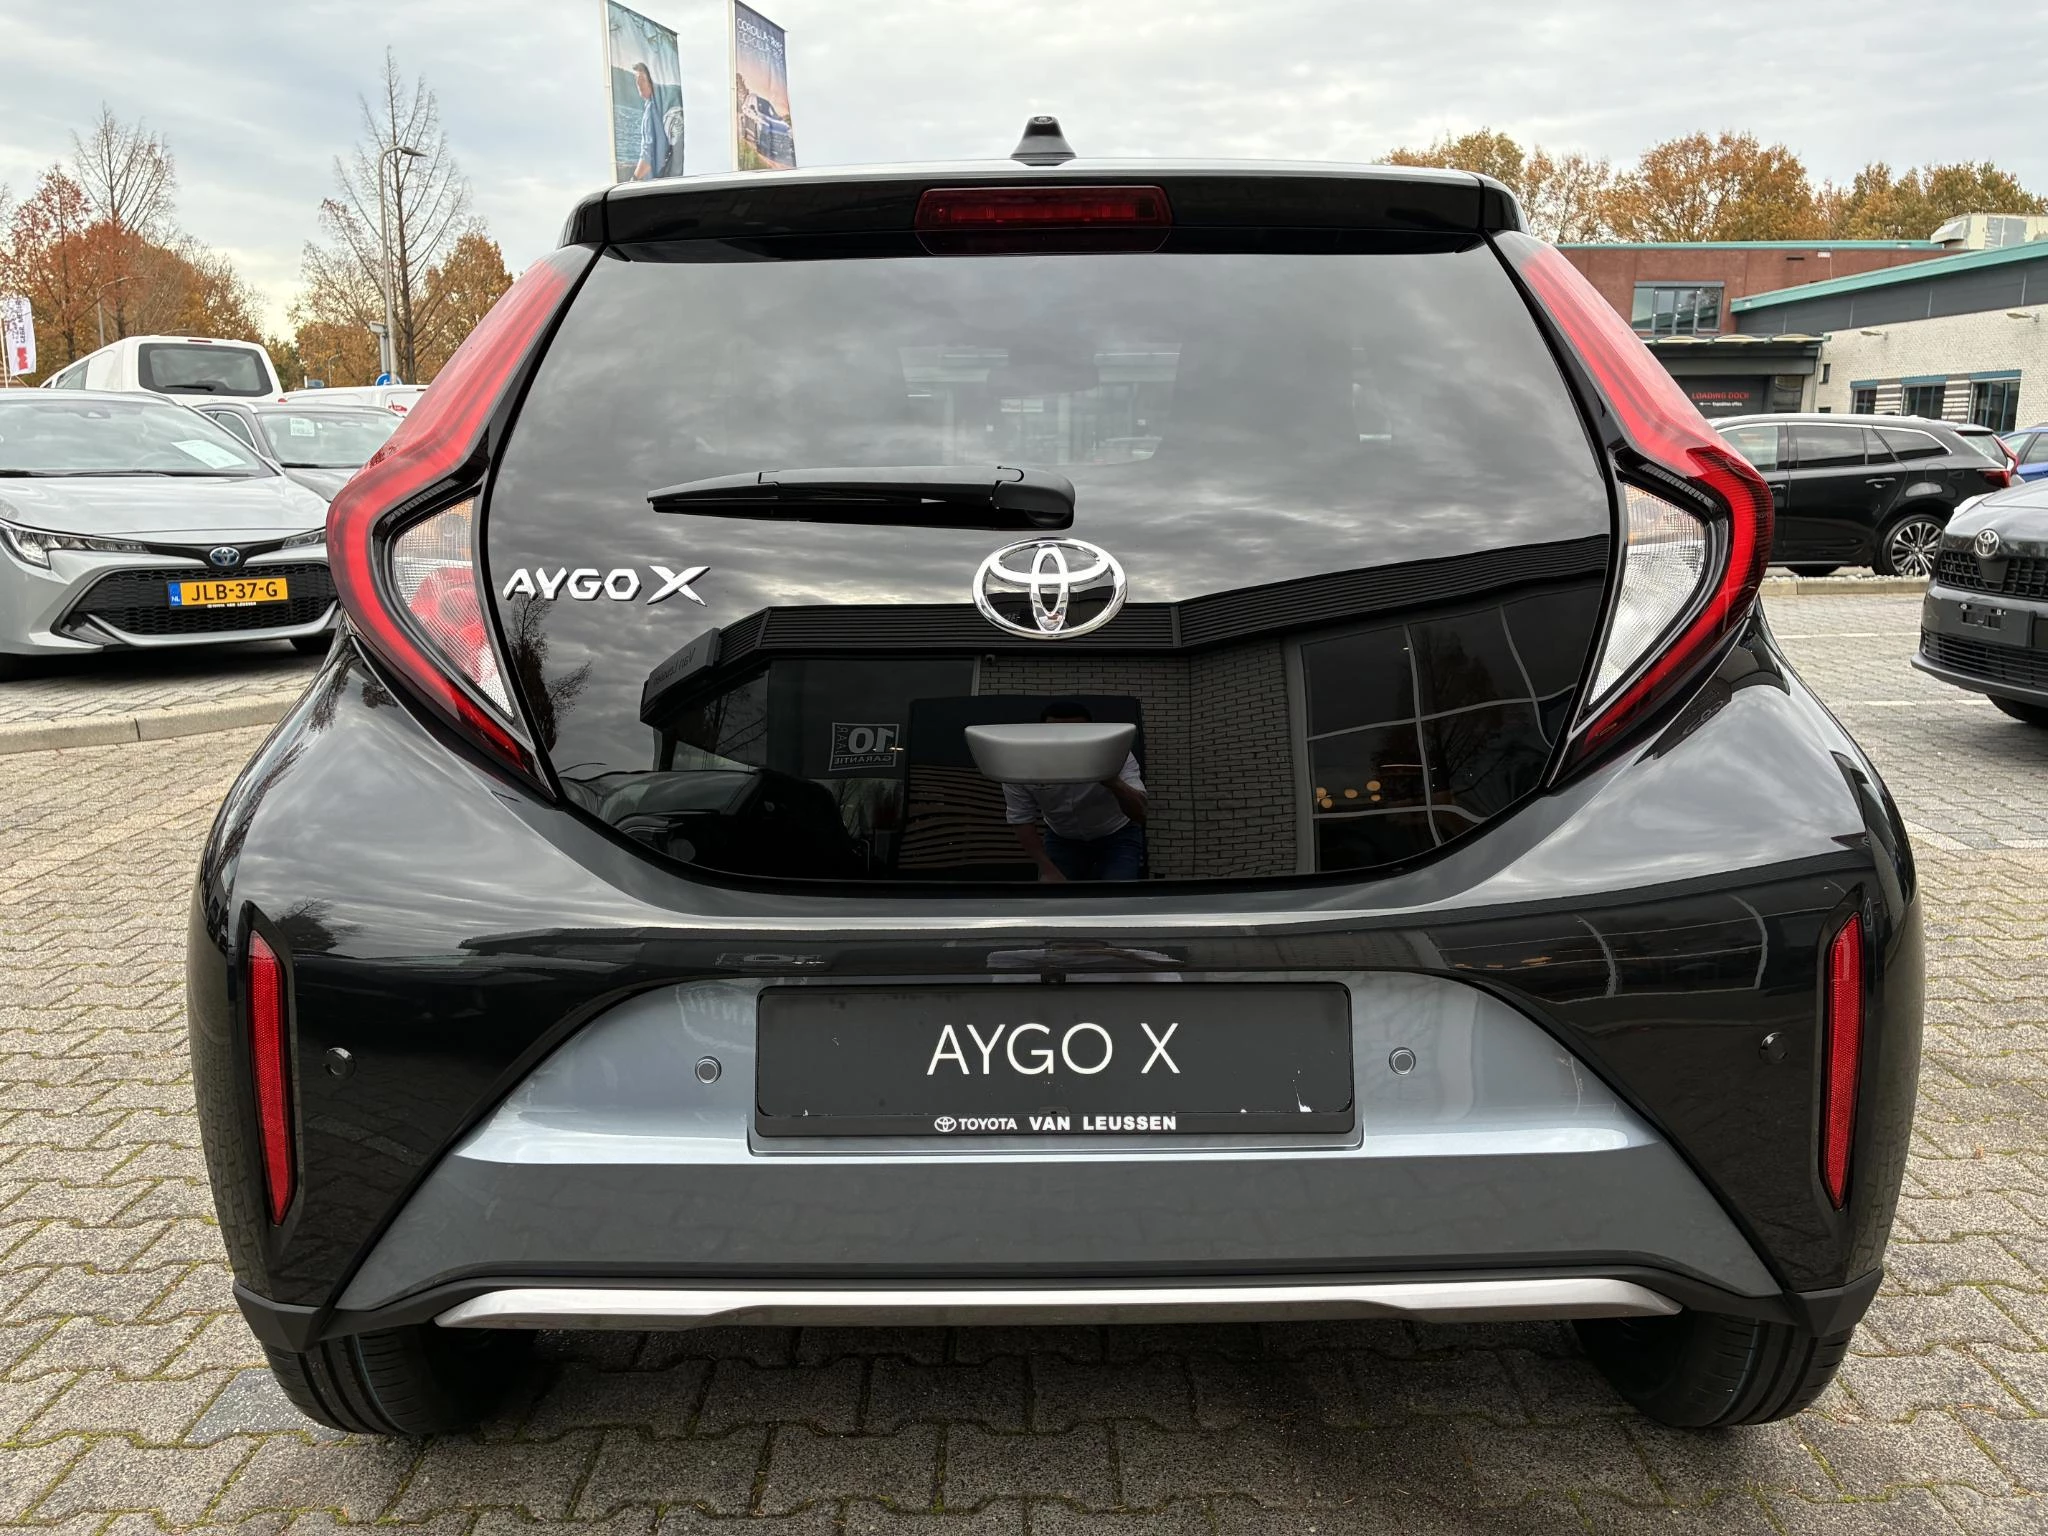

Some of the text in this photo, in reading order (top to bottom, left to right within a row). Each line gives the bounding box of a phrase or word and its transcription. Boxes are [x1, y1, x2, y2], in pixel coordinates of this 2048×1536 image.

[1692, 391, 1727, 400] LOADING
[191, 581, 278, 601] JLB-37-G
[502, 565, 711, 607] AYGO X
[171, 595, 181, 603] NL
[926, 1021, 1181, 1076] AYGO X
[959, 1116, 1177, 1131] TOYOTA VAN LEUSSEN
